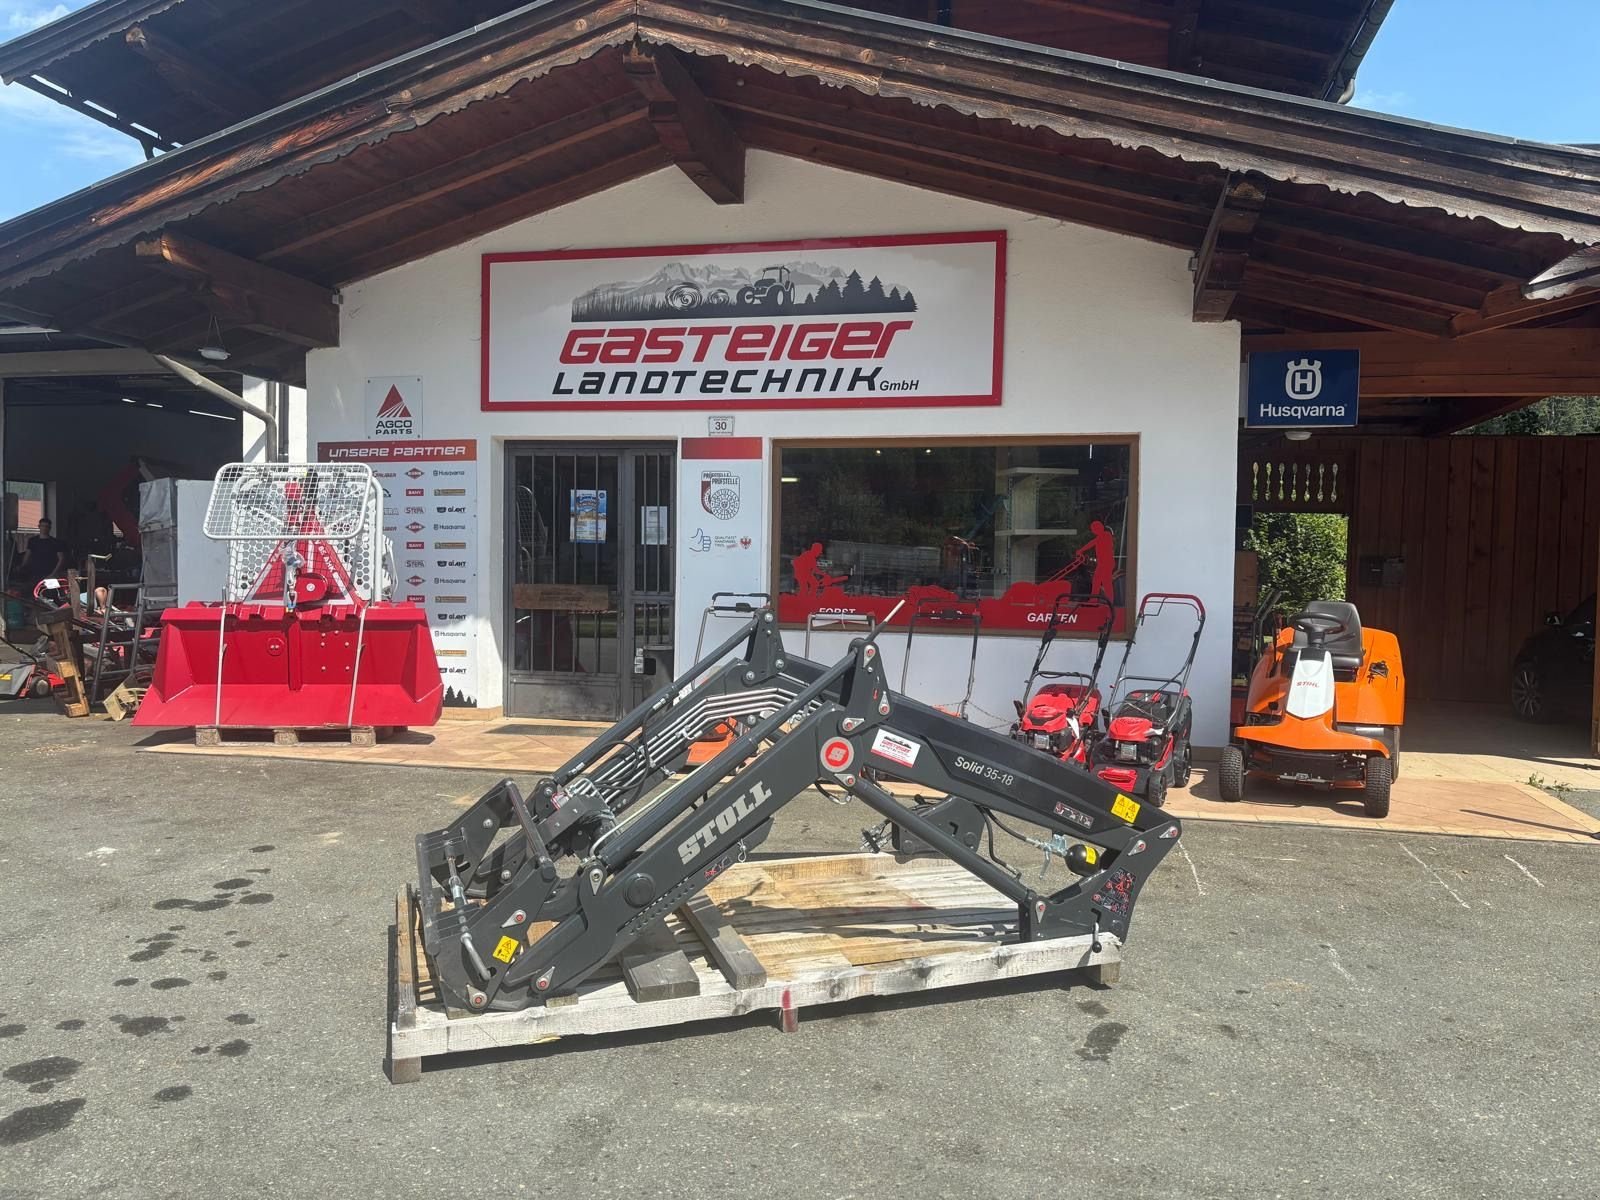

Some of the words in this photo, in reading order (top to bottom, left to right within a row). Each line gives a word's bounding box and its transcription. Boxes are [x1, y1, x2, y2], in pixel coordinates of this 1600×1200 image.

[879, 379, 919, 392] GmbH
[1260, 403, 1345, 419] Husqvarna
[376, 420, 412, 428] AGCO
[715, 421, 727, 431] 30
[954, 756, 985, 775] Solid
[983, 767, 1014, 786] 35-18
[677, 780, 773, 865] STOLL
